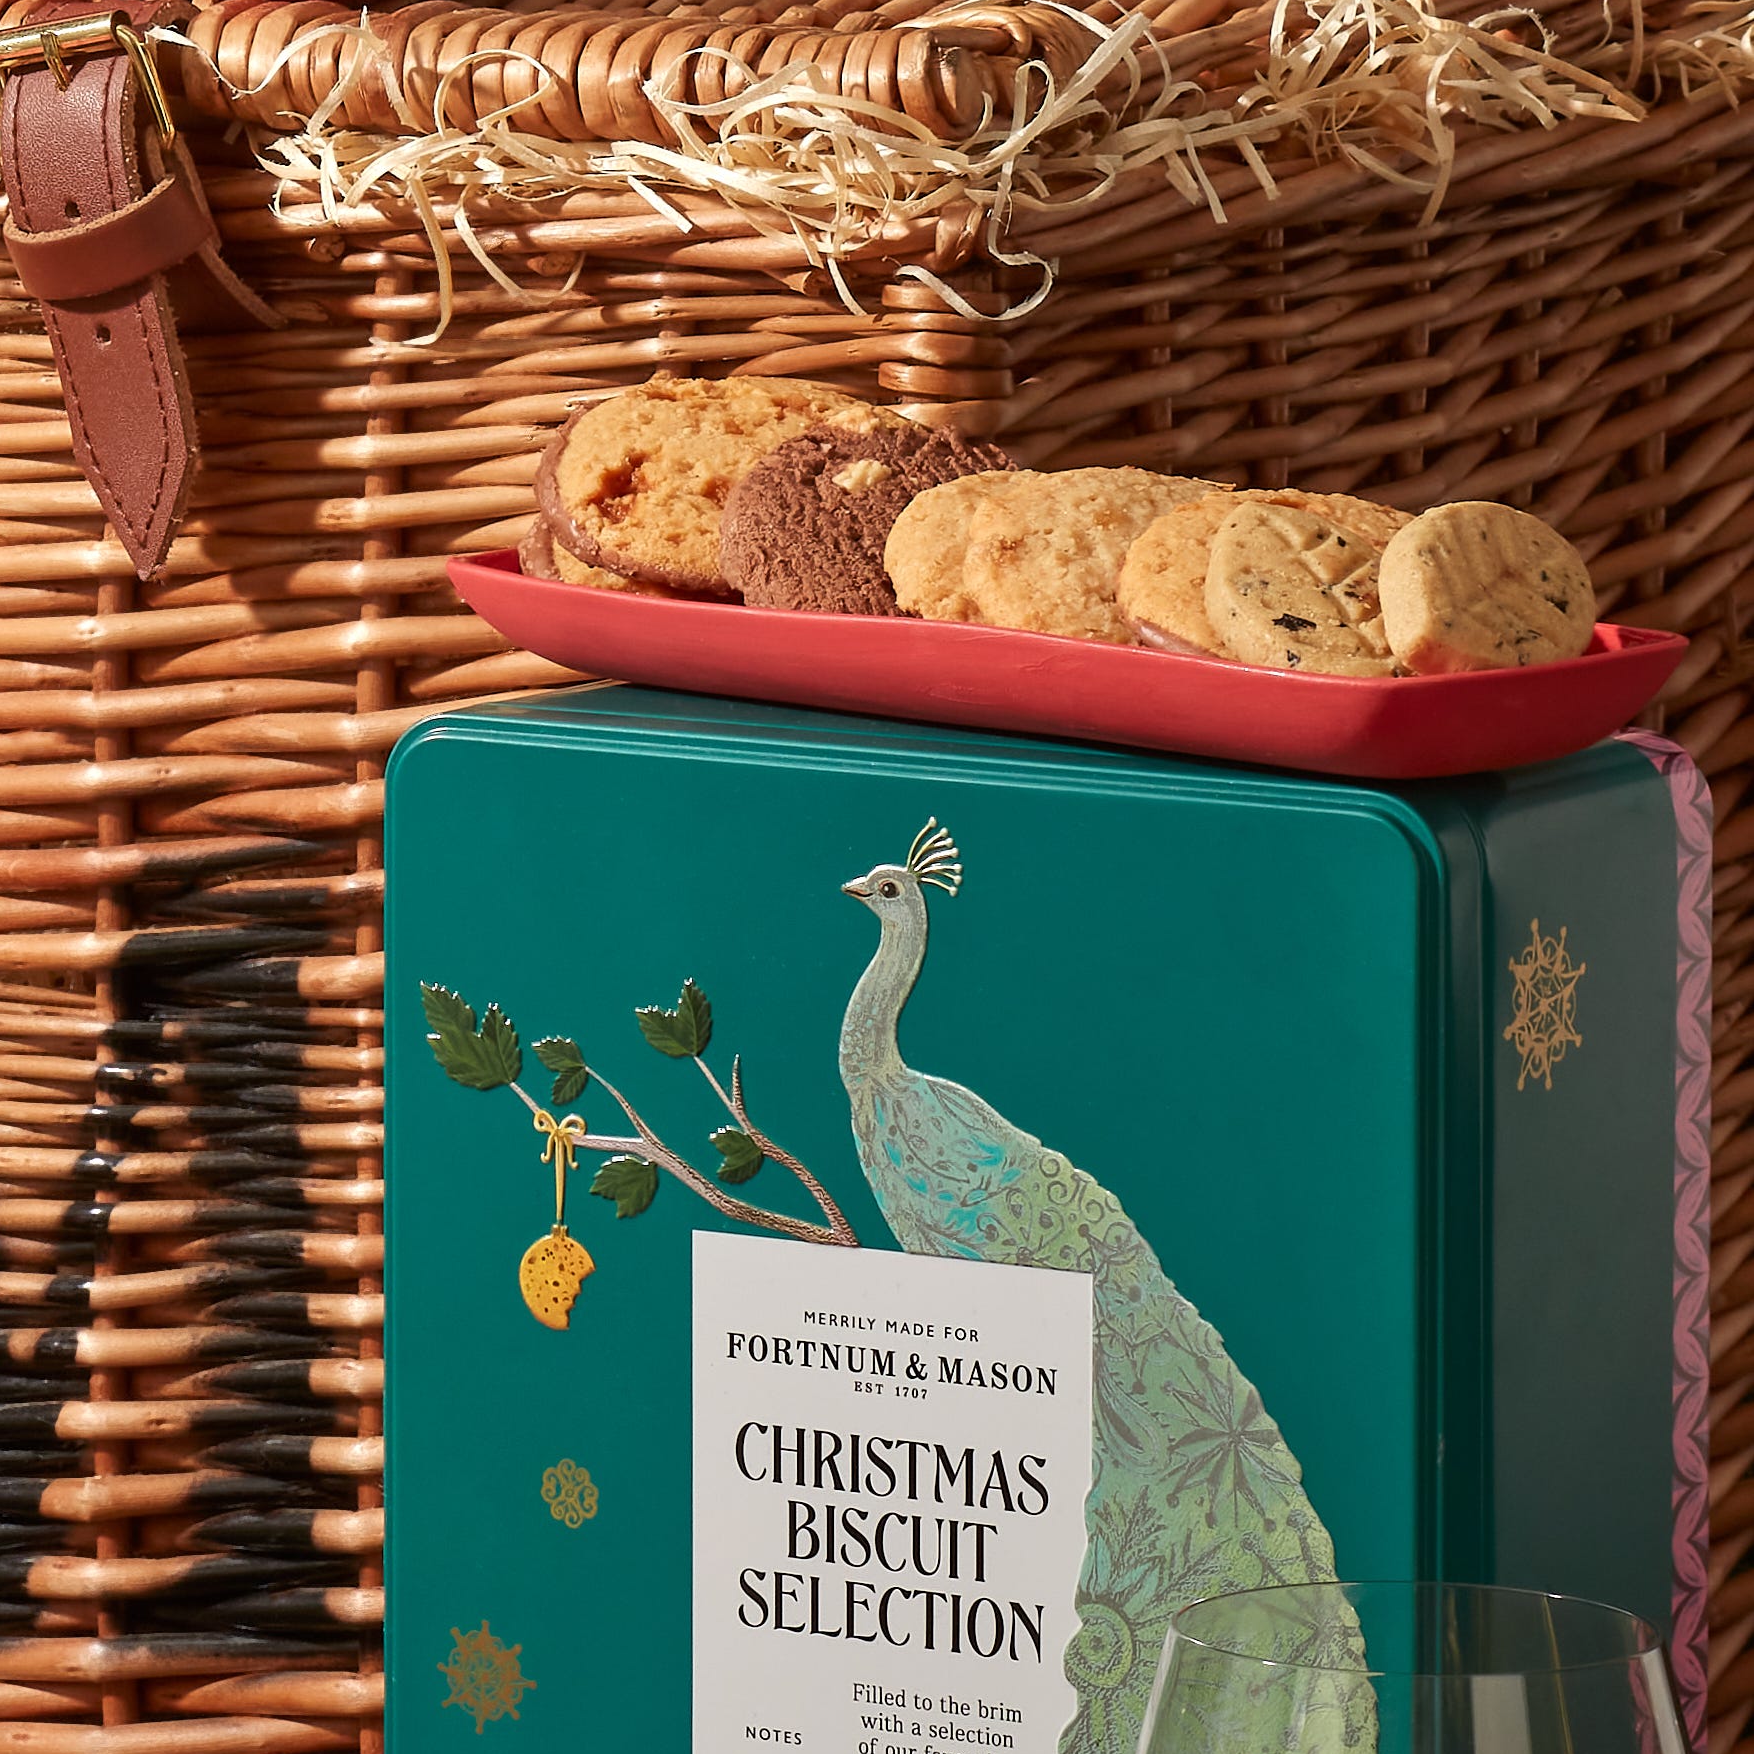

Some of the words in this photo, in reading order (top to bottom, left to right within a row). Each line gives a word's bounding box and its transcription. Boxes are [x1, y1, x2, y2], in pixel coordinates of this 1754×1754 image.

[804, 1310, 877, 1331] MERRILY
[885, 1319, 935, 1338] MADE
[944, 1326, 979, 1343] FOR
[726, 1331, 897, 1378] FORTNUM
[905, 1352, 929, 1381] &
[937, 1355, 1058, 1396] MASON
[735, 1421, 1049, 1516] CHRISTMAS
[787, 1499, 999, 1583] BISCUIT
[738, 1567, 1045, 1664] SELECTION
[853, 1682, 907, 1709] Filled
[913, 1693, 933, 1712] to
[939, 1695, 971, 1717] the
[977, 1698, 1023, 1724] brim
[745, 1725, 802, 1746] NOTES
[860, 1712, 904, 1734] with
[911, 1721, 922, 1737] a
[928, 1721, 1014, 1749] selection
